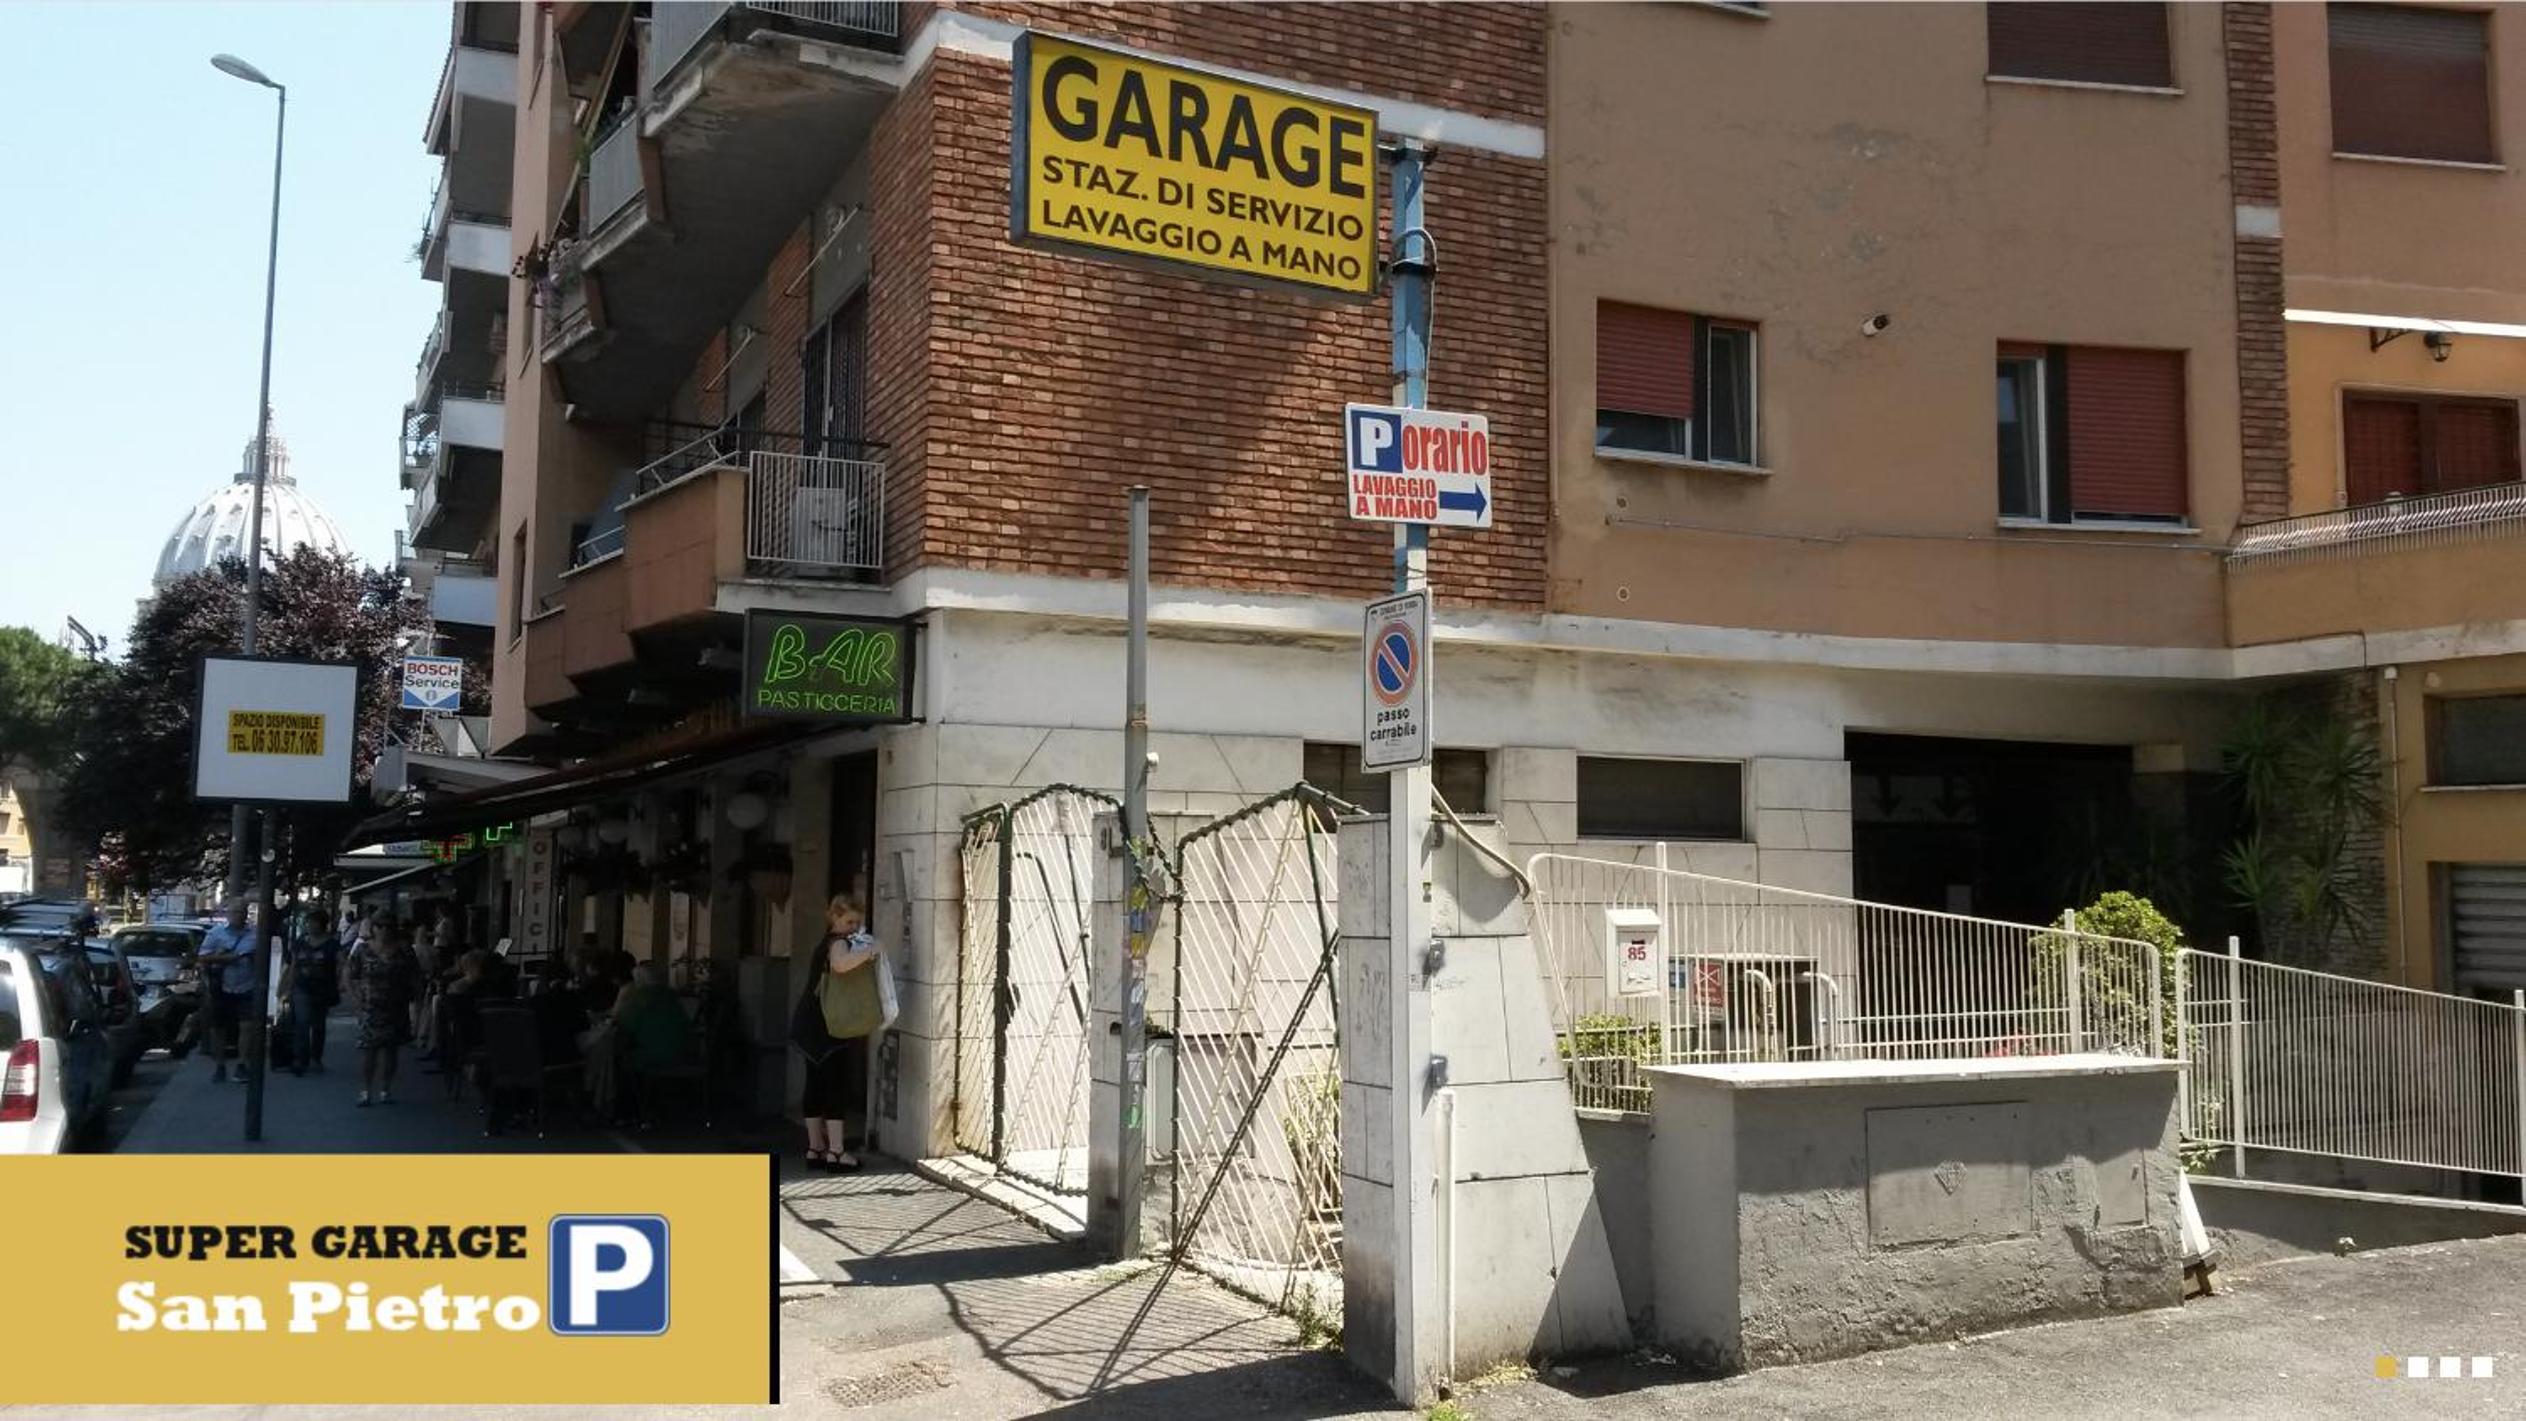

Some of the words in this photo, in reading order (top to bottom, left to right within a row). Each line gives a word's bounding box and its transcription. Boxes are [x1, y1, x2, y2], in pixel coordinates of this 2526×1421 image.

[1042, 55, 1365, 199] GARAGE
[1043, 156, 1148, 200] STAZ.
[1158, 177, 1193, 210] DI
[1207, 187, 1363, 241] SERVIZIO
[1043, 200, 1222, 255] LAVAGGIO
[1229, 236, 1252, 262] A
[1262, 240, 1361, 281] MANO
[1360, 417, 1393, 467] P
[1402, 420, 1487, 475] orario
[1353, 474, 1437, 499] LAVAGGIO
[1356, 496, 1369, 516] A
[1375, 497, 1437, 520] MANO
[765, 624, 895, 686] BAR
[405, 674, 459, 689] Service
[407, 663, 459, 676] BOSCH
[758, 689, 896, 714] PASTICCERIA
[233, 713, 264, 729] SPAZIO
[266, 714, 320, 730] DISPONIBILE
[1377, 708, 1409, 726] passo
[1370, 722, 1417, 741] carrabile
[1628, 946, 1646, 960] 85
